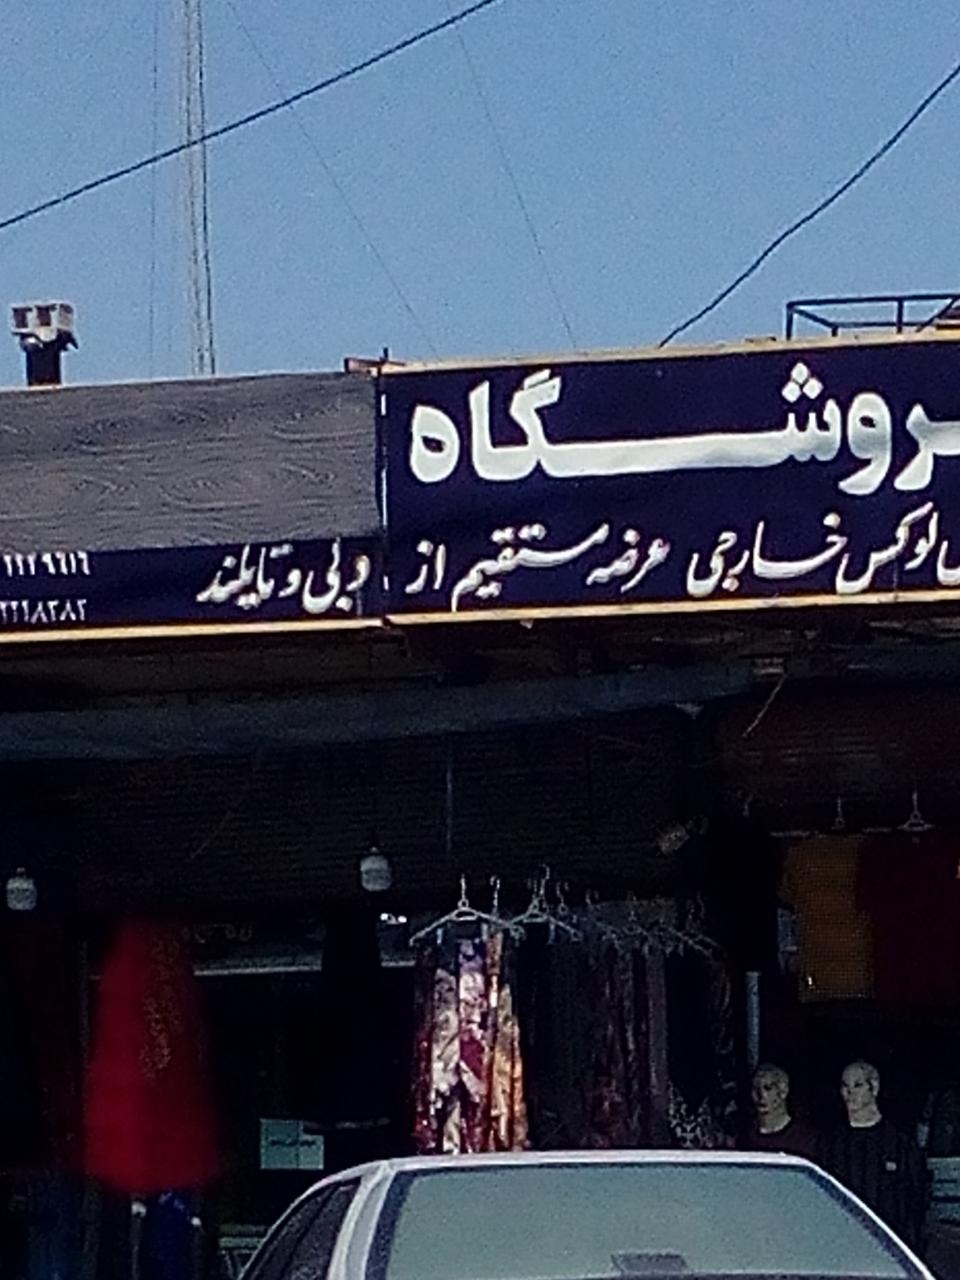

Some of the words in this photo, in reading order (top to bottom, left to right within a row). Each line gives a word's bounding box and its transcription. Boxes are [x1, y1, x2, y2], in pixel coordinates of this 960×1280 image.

[196, 542, 294, 611] تایلند
[278, 567, 302, 597] و
[302, 536, 370, 614] دبی
[405, 539, 446, 594] از
[451, 523, 610, 612] مستقیم
[586, 528, 671, 594] عرضه
[686, 512, 848, 597] خارجی
[835, 501, 939, 595] لوکس
